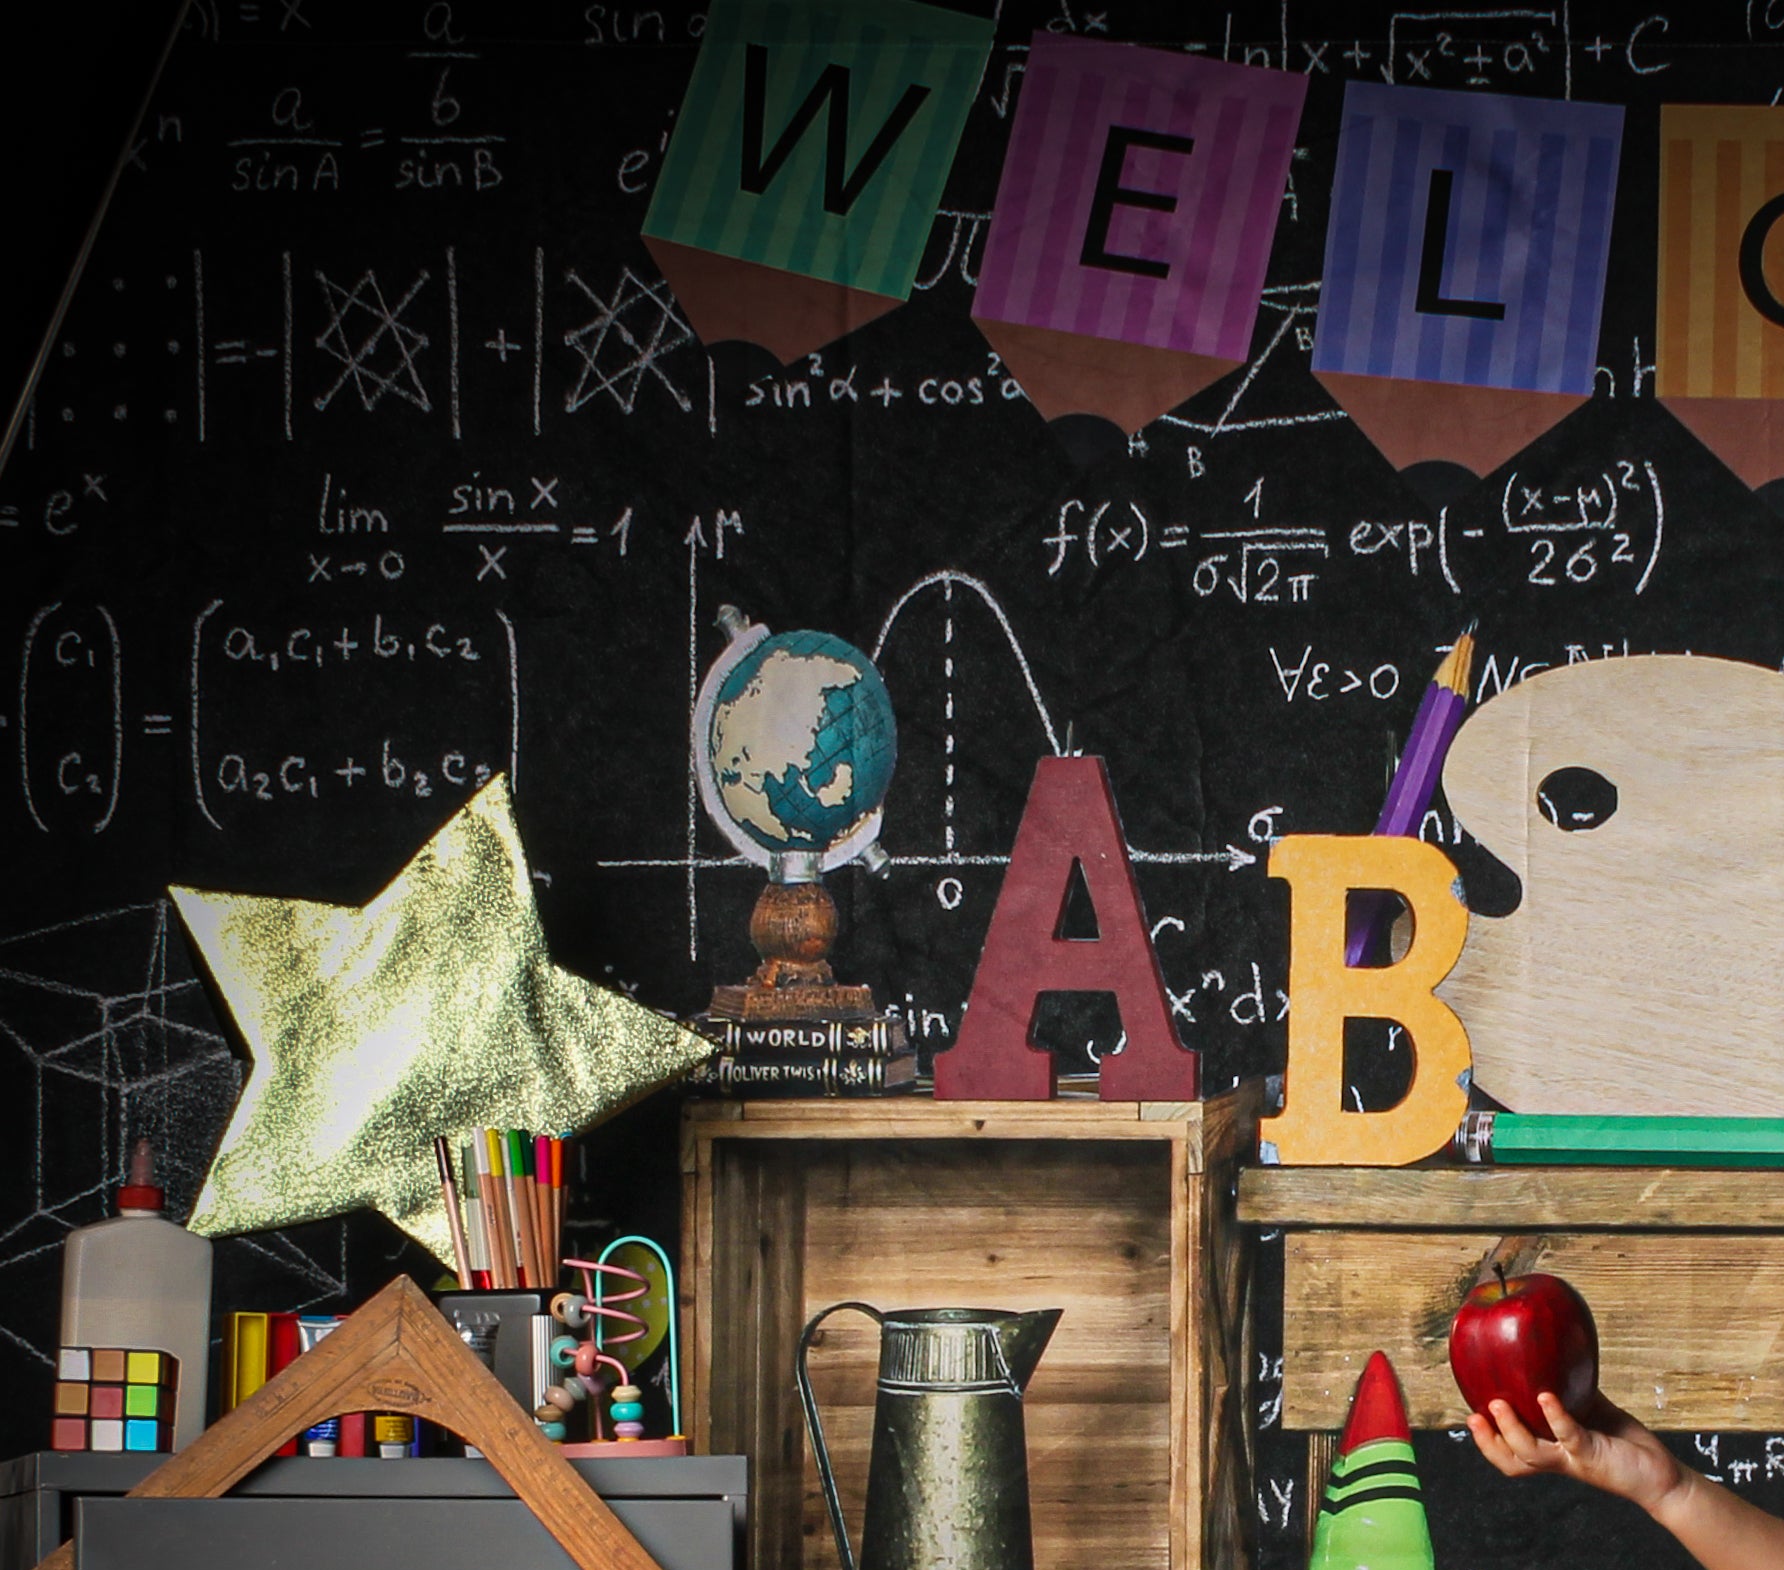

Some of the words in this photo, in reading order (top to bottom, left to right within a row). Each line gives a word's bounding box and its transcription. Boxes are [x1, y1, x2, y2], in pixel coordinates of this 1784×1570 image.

[932, 755, 1202, 1102] A
[1257, 832, 1474, 1167] B
[746, 1028, 826, 1048] WORLD
[732, 1064, 780, 1083] OLIVER
